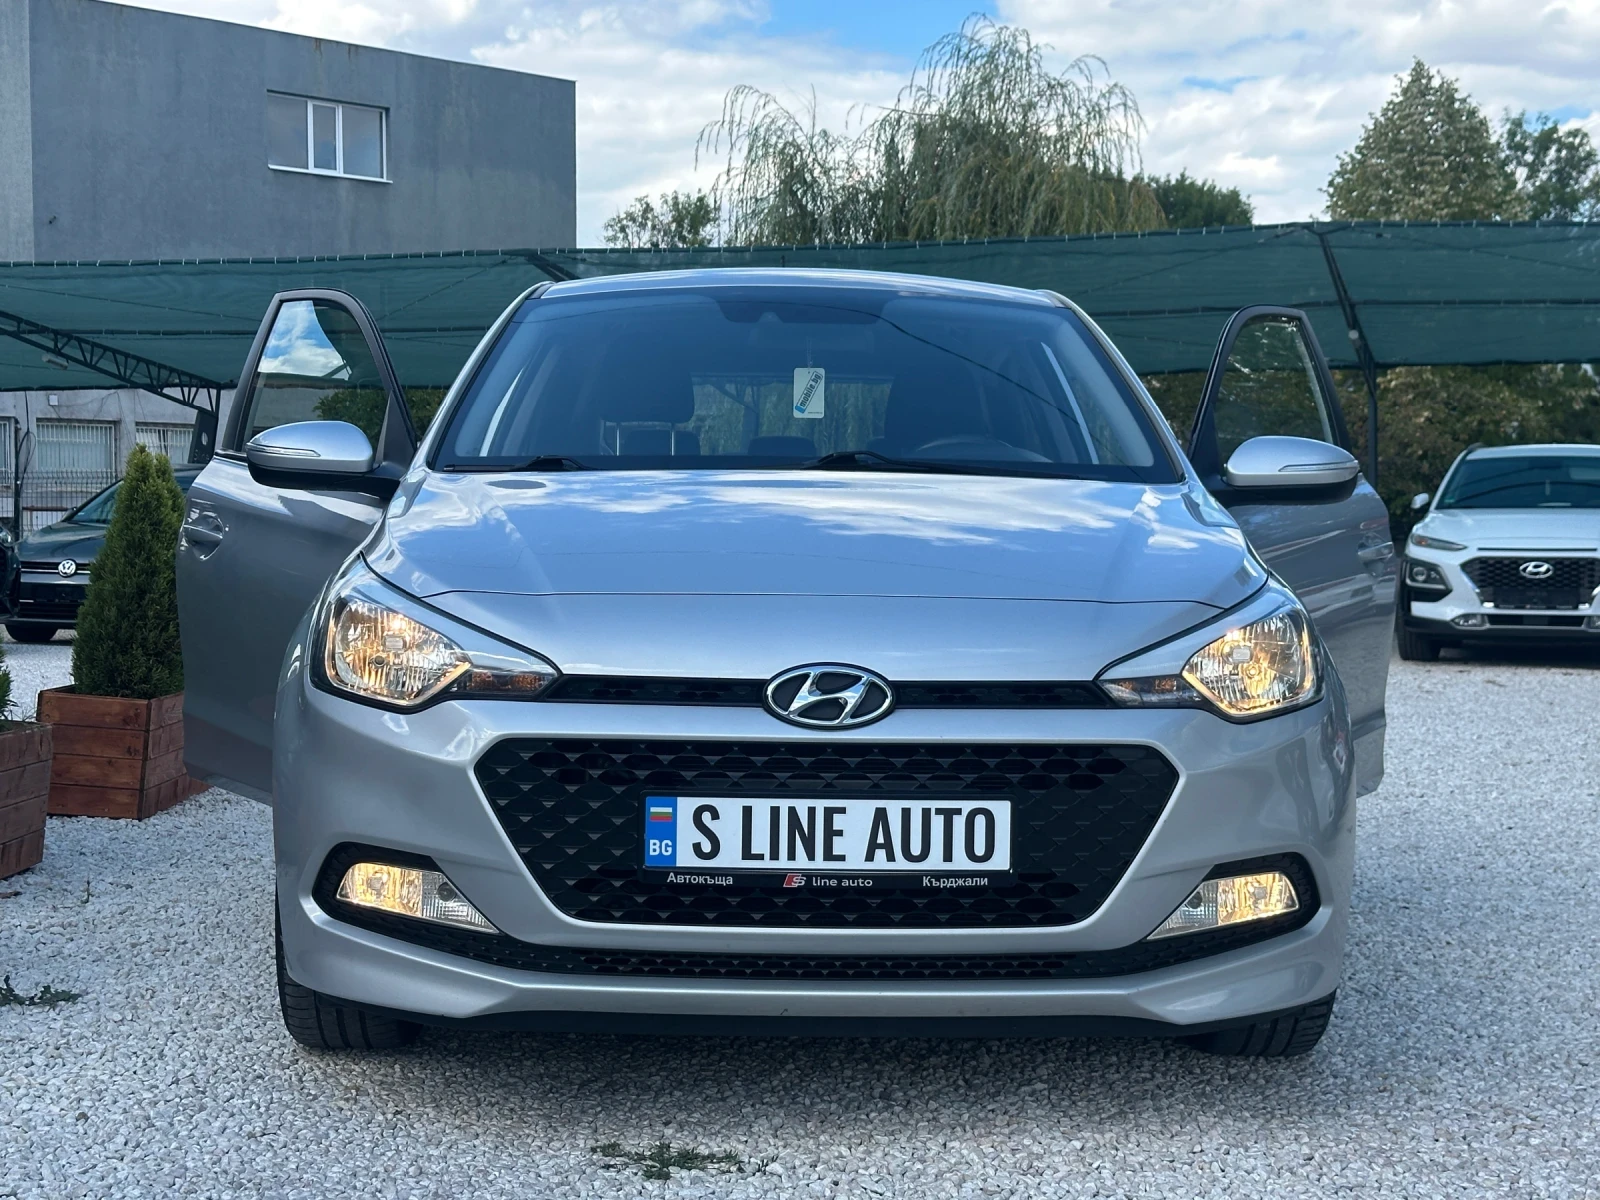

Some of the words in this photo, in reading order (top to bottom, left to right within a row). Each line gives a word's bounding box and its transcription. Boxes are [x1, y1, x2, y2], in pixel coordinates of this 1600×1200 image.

[691, 803, 721, 861] S
[741, 805, 847, 863] LINE
[864, 806, 996, 864] AUTO
[649, 839, 673, 856] BG
[666, 872, 734, 886] Автокъща
[812, 876, 838, 887] line
[841, 877, 873, 887] auto
[922, 875, 988, 888] Кърджали
